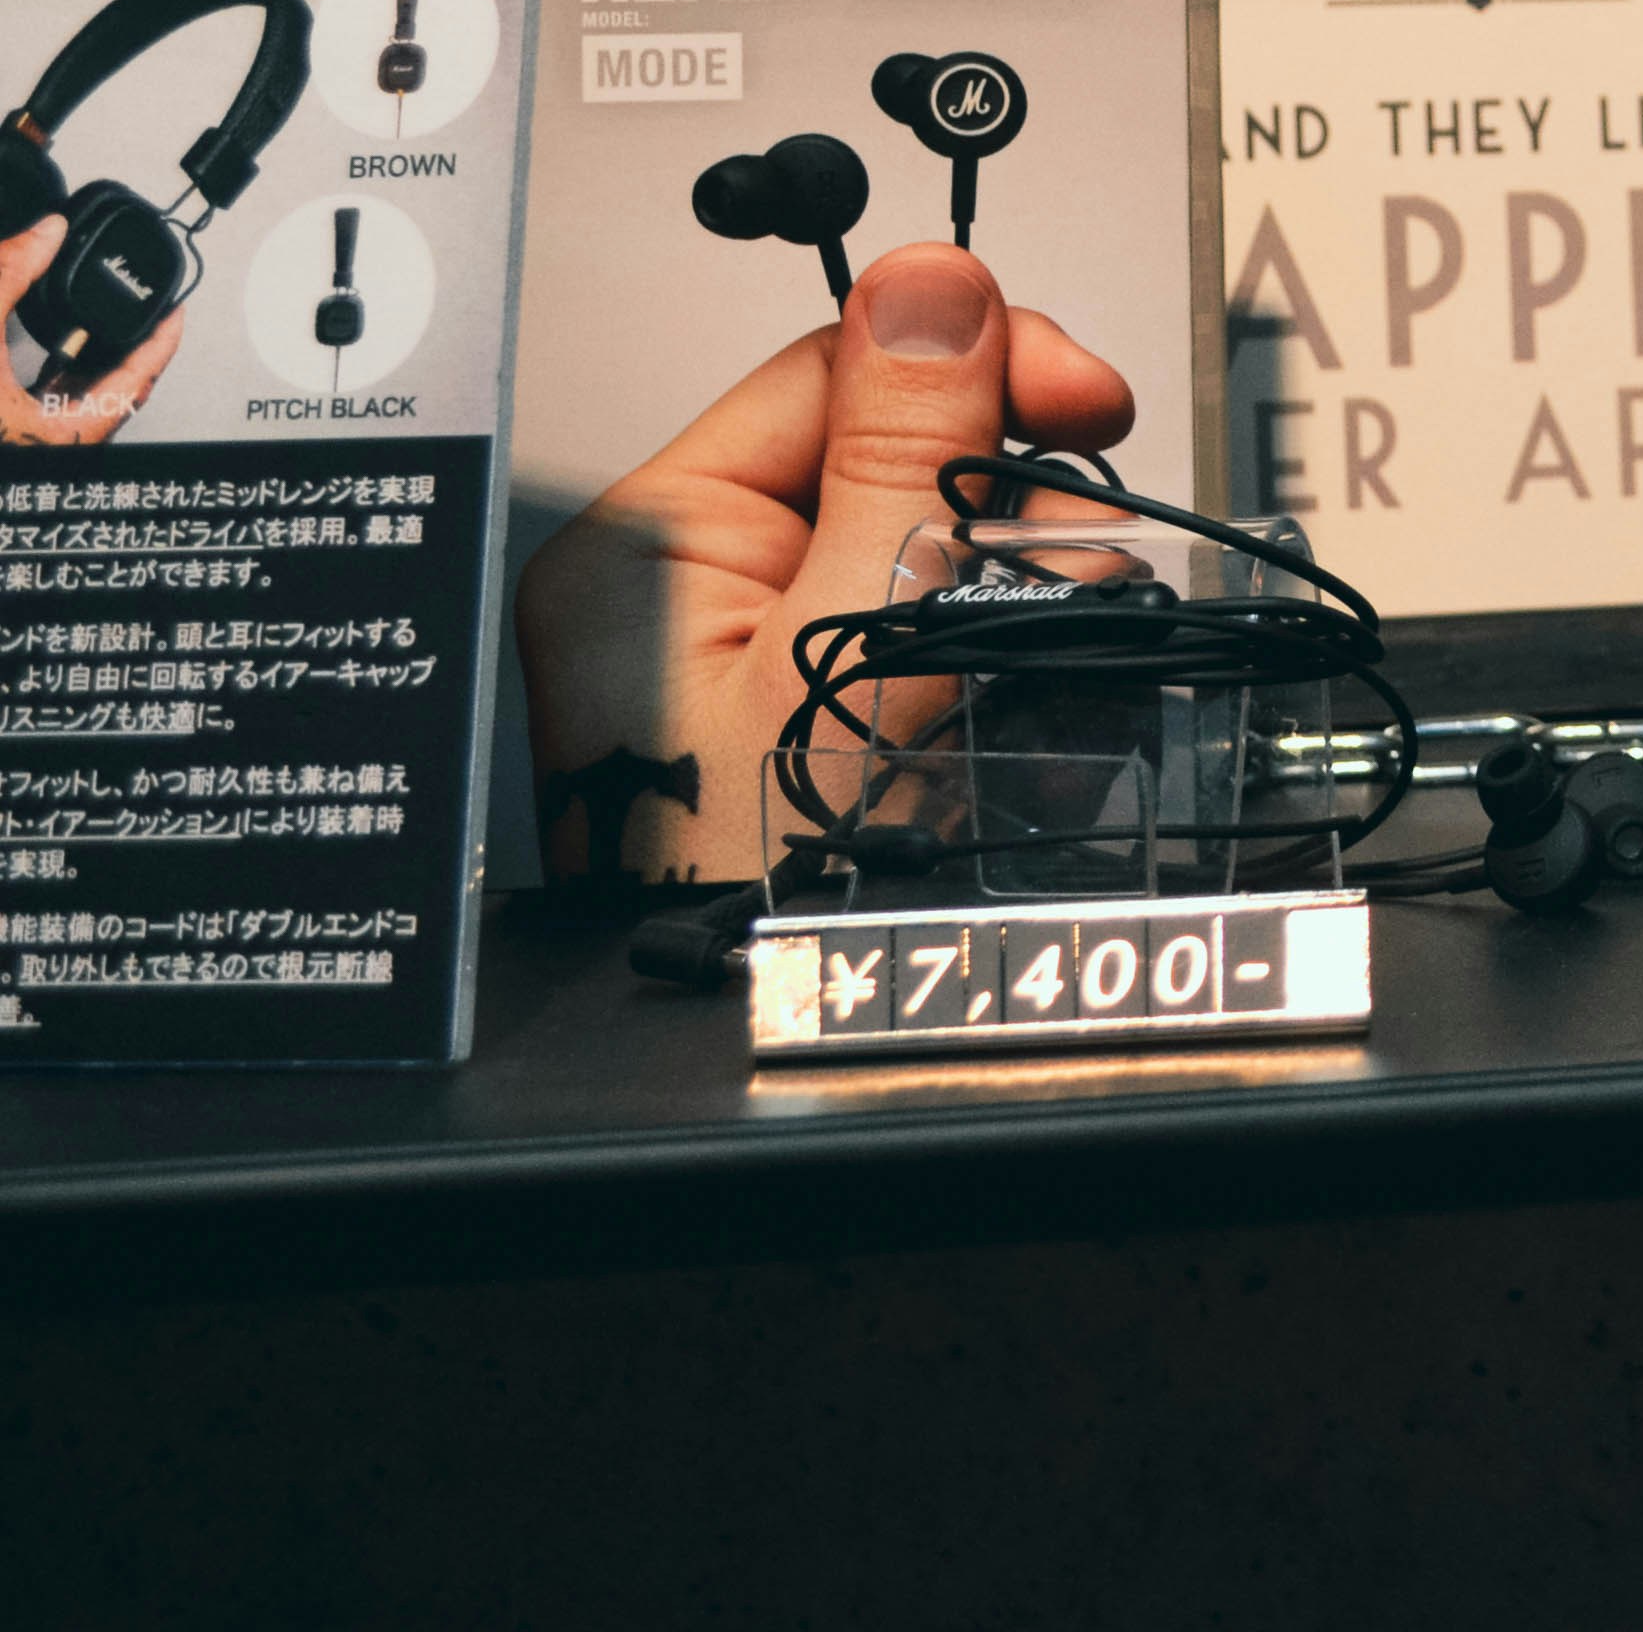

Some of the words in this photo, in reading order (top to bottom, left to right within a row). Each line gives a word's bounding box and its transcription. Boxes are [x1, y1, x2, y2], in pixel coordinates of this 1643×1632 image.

[582, 11, 649, 29] MODEL:
[596, 47, 728, 89] MODE
[1221, 103, 1328, 161] ND
[1377, 96, 1552, 156] THEY
[348, 154, 457, 179] BROWN
[43, 392, 138, 418] BLACK
[247, 399, 321, 421] PITCH
[331, 396, 417, 419] BLACK
[0, 475, 435, 513] 低音と洗練されたミッドレンジを実現
[0, 557, 272, 593] 楽しむことができます。
[937, 581, 1084, 603] Marshall
[0, 804, 406, 838] ト・イアークッション」により装着時
[0, 849, 78, 880] 実現。
[823, 935, 1271, 1024] ¥7,400-
